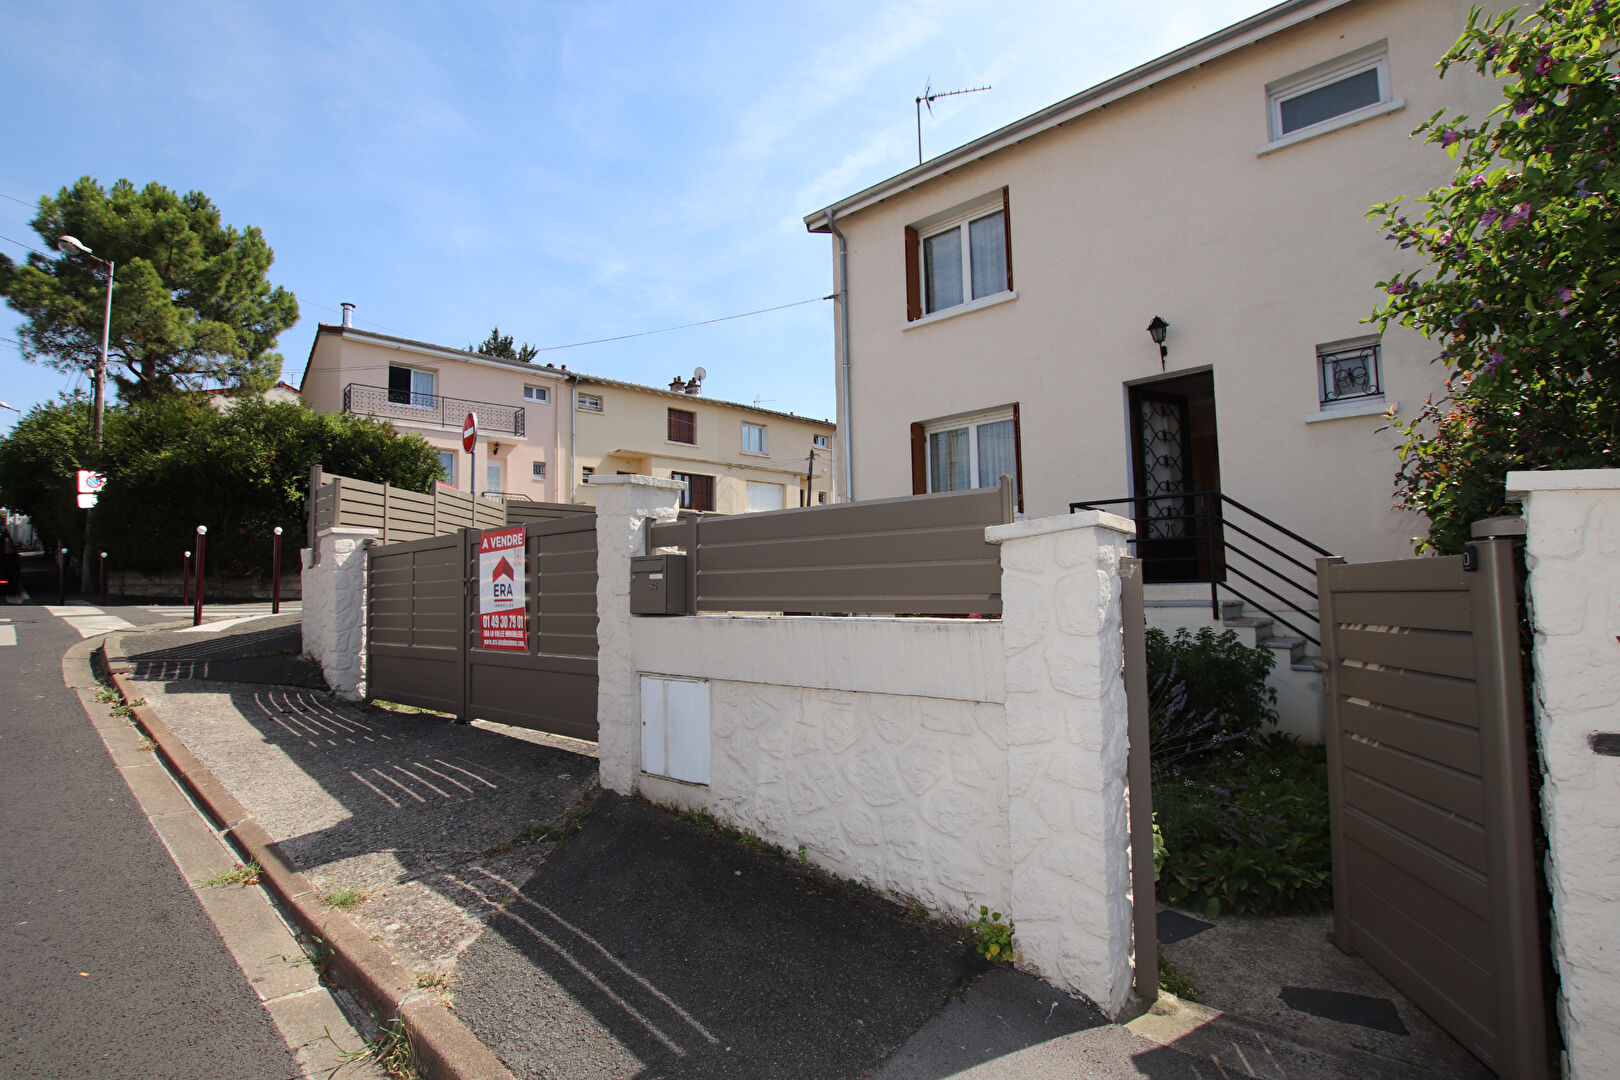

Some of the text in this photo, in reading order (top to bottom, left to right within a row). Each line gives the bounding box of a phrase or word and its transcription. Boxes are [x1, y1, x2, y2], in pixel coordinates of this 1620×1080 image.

[482, 533, 523, 549] A VENDRE
[493, 583, 513, 597] ERA
[482, 615, 523, 628] 01 49 30 79 01
